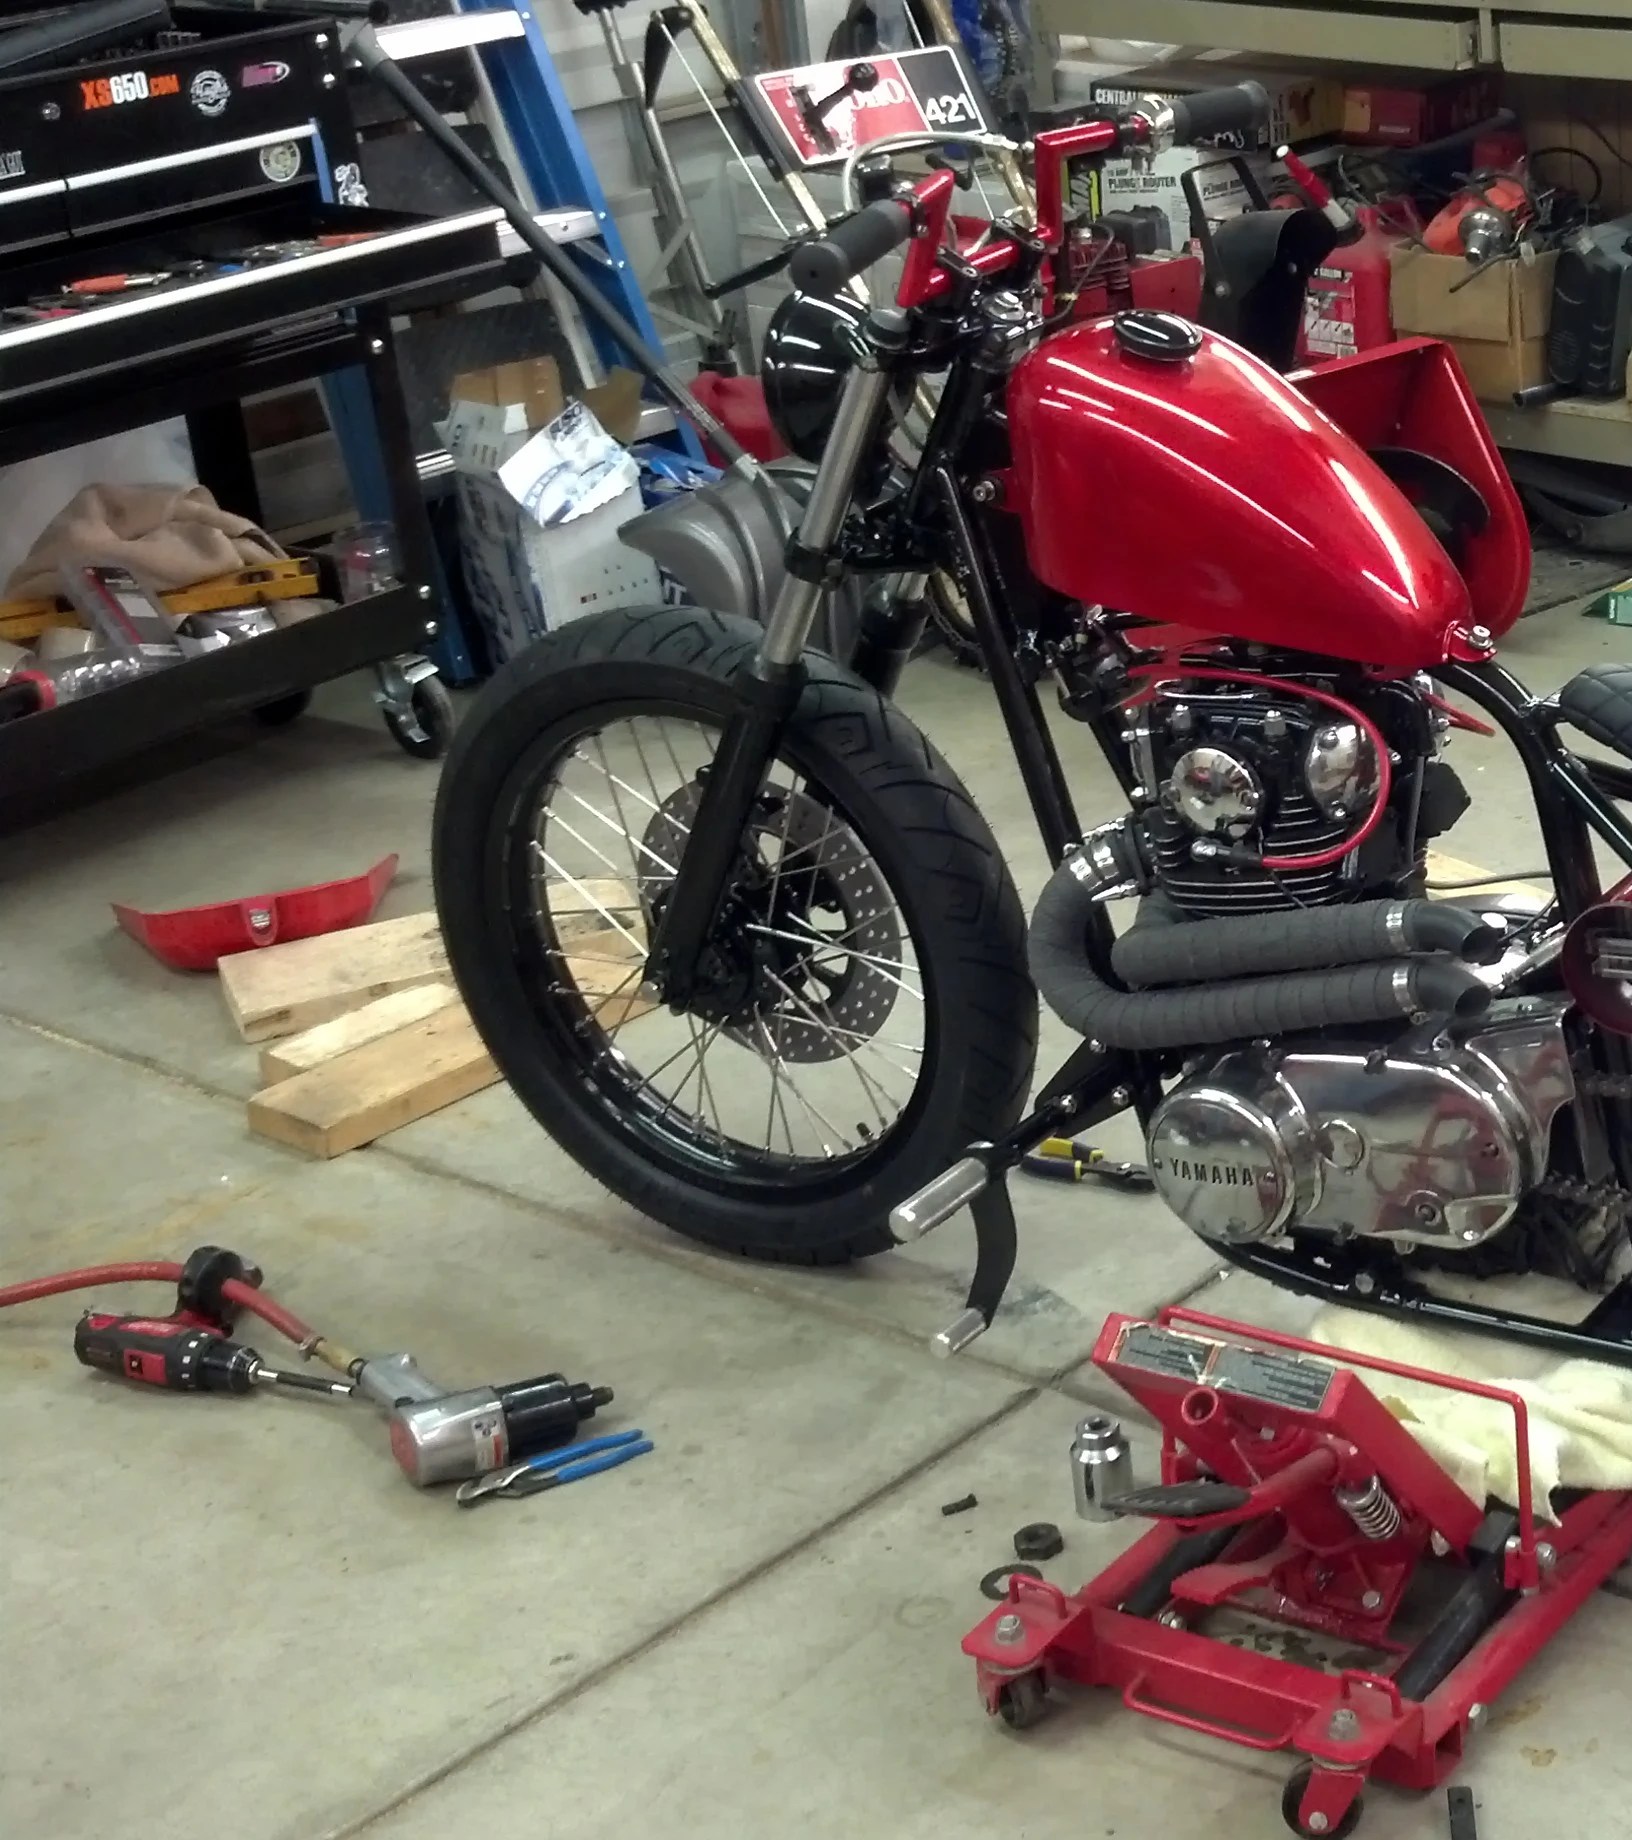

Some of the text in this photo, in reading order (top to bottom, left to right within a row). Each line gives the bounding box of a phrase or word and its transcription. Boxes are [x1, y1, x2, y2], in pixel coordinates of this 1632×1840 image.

[925, 93, 978, 125] 421
[1143, 176, 1177, 188] ROUTER
[1169, 1157, 1254, 1187] YAMAHA
